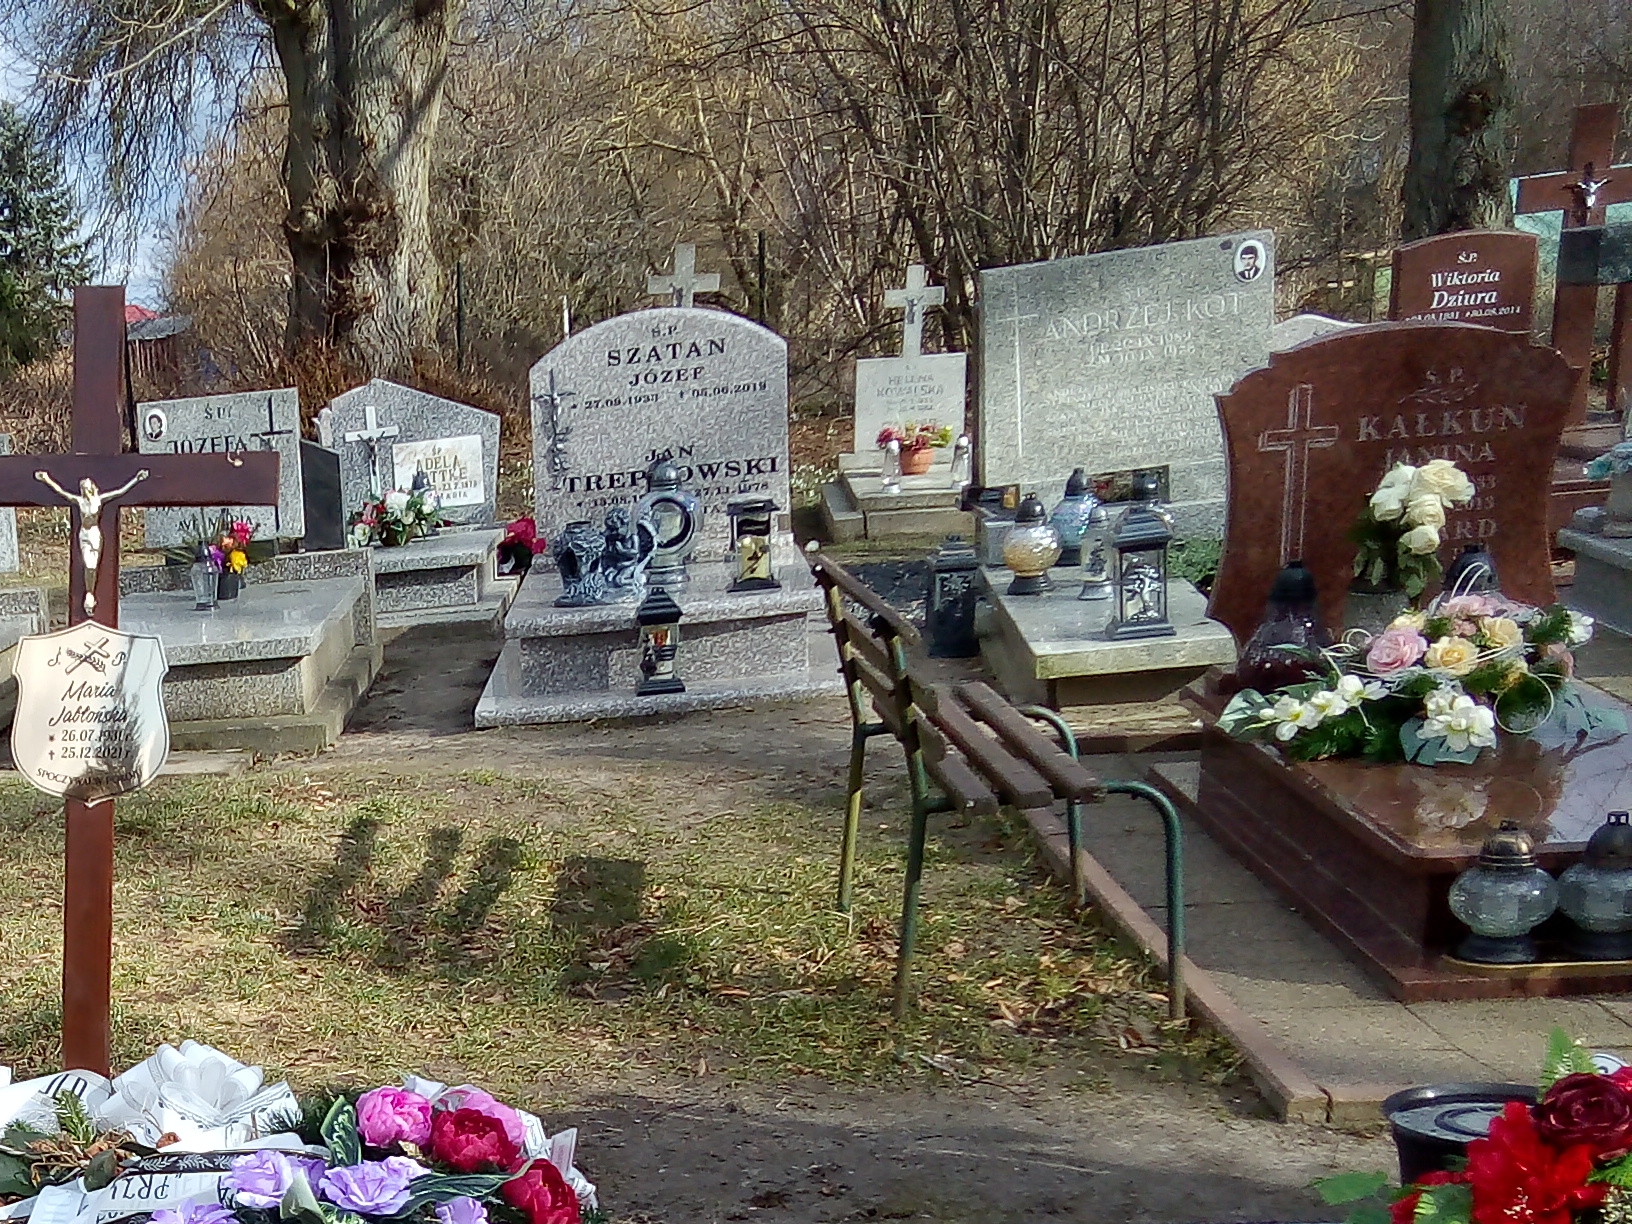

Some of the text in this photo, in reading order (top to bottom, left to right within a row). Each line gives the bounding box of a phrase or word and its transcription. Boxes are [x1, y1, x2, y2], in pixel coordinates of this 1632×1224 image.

[1431, 268, 1500, 288] Wiktoria
[1430, 289, 1497, 310] Dziura
[1046, 292, 1241, 339] ANDRZEJ KOT
[606, 337, 727, 367] SZATAN
[628, 366, 706, 387] JÓZEF
[1355, 402, 1528, 442] KAŁKUN
[415, 454, 461, 473] ADELA
[644, 445, 695, 462] JAN
[424, 467, 469, 483] TTKE
[563, 456, 781, 493] TREPOWSKI
[61, 680, 117, 702] Maria
[48, 705, 128, 727] Jabłońska
